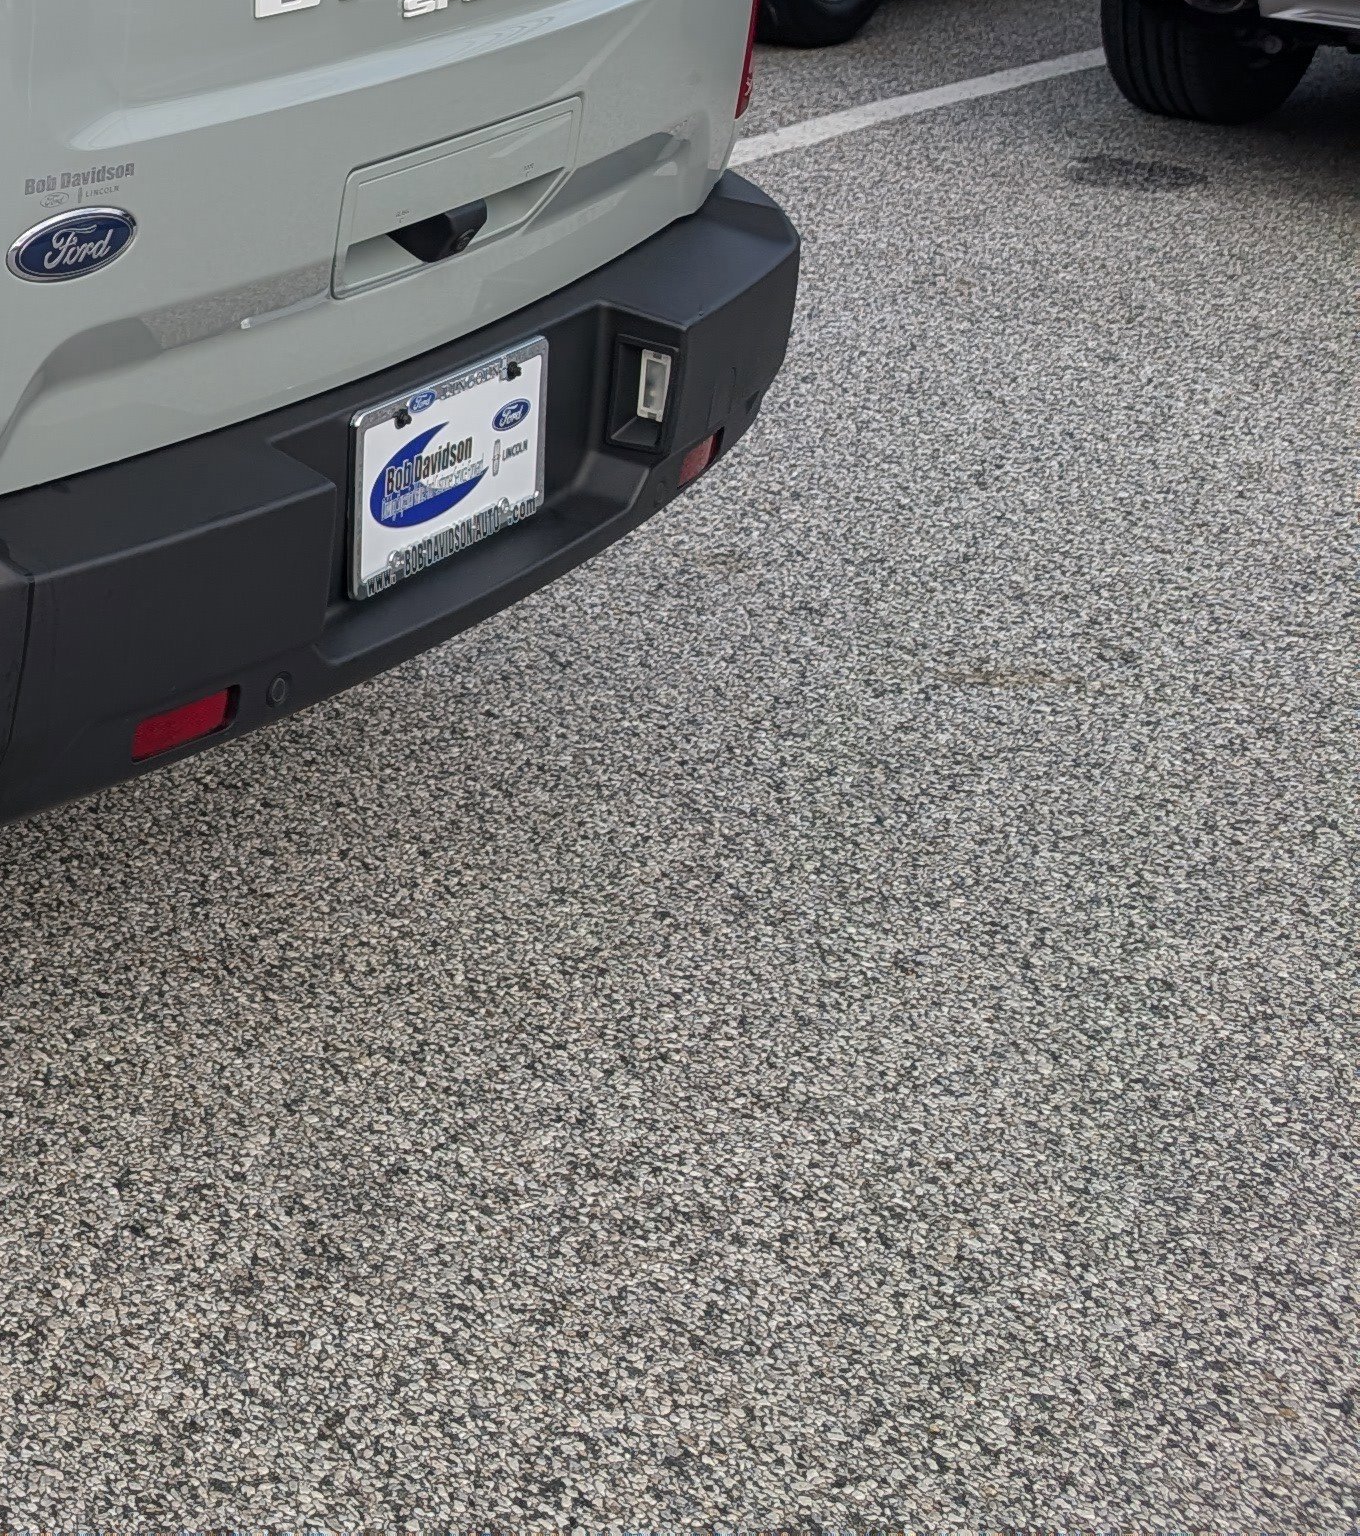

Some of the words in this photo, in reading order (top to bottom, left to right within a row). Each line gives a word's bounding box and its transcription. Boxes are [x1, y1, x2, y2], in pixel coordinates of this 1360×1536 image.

[24, 174, 57, 196] Bob
[60, 162, 135, 189] Davidson
[85, 185, 120, 198] LINCOLN
[43, 224, 114, 270] Ford
[386, 459, 412, 497] Bob
[414, 436, 473, 482] Davidson
[502, 439, 528, 462] LINCOLN
